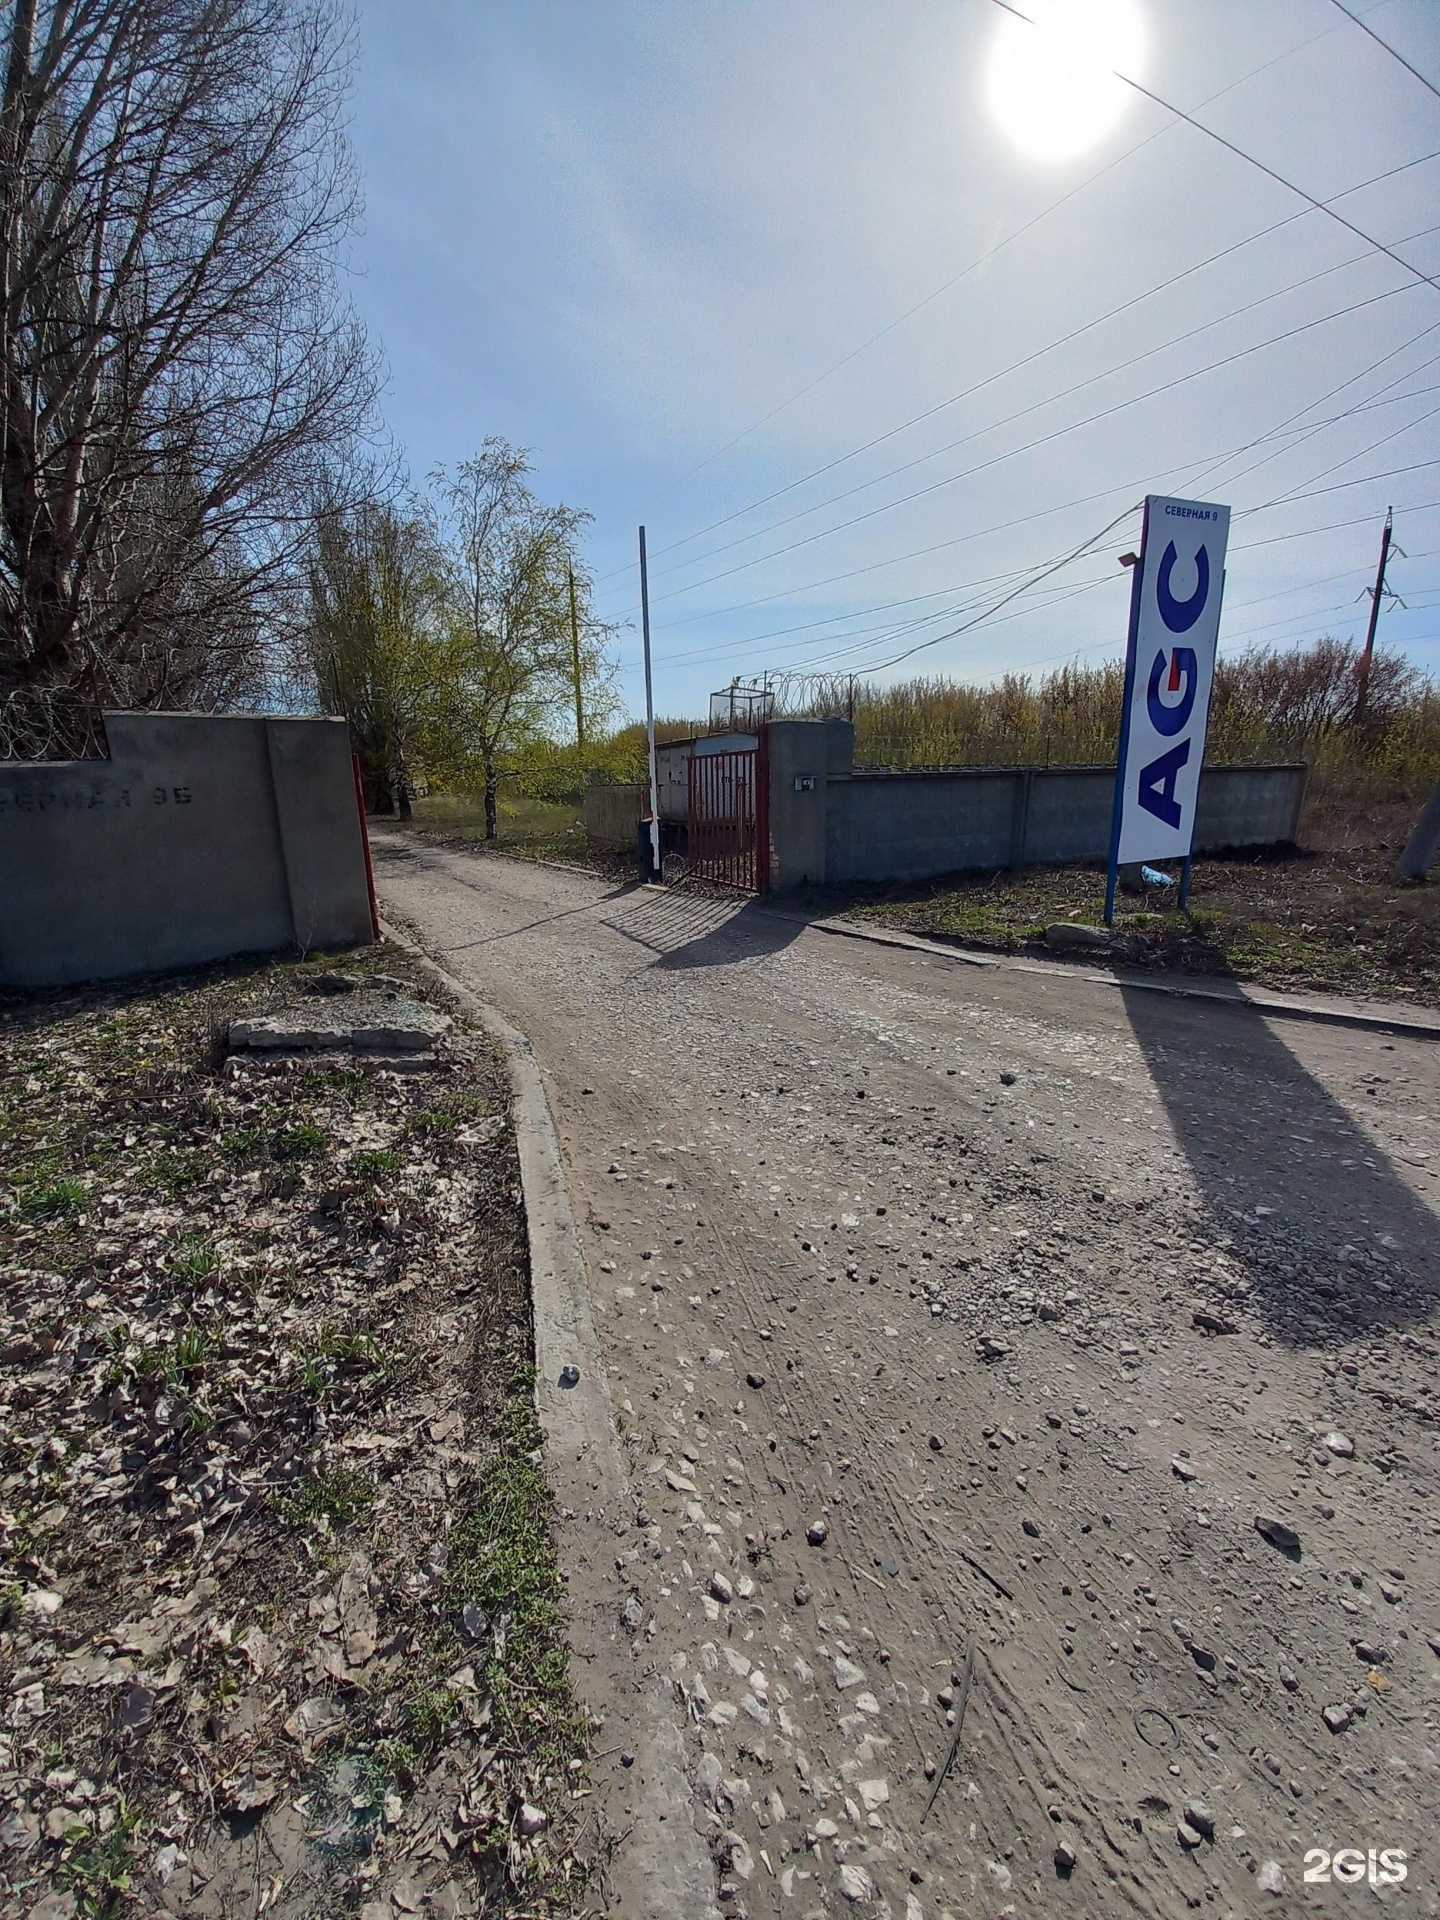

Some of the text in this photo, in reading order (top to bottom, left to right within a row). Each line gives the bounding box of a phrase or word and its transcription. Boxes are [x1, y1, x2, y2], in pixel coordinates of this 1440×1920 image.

[1165, 505, 1218, 521] СЕВЕРНАЯ 9
[1138, 539, 1210, 831] AGC
